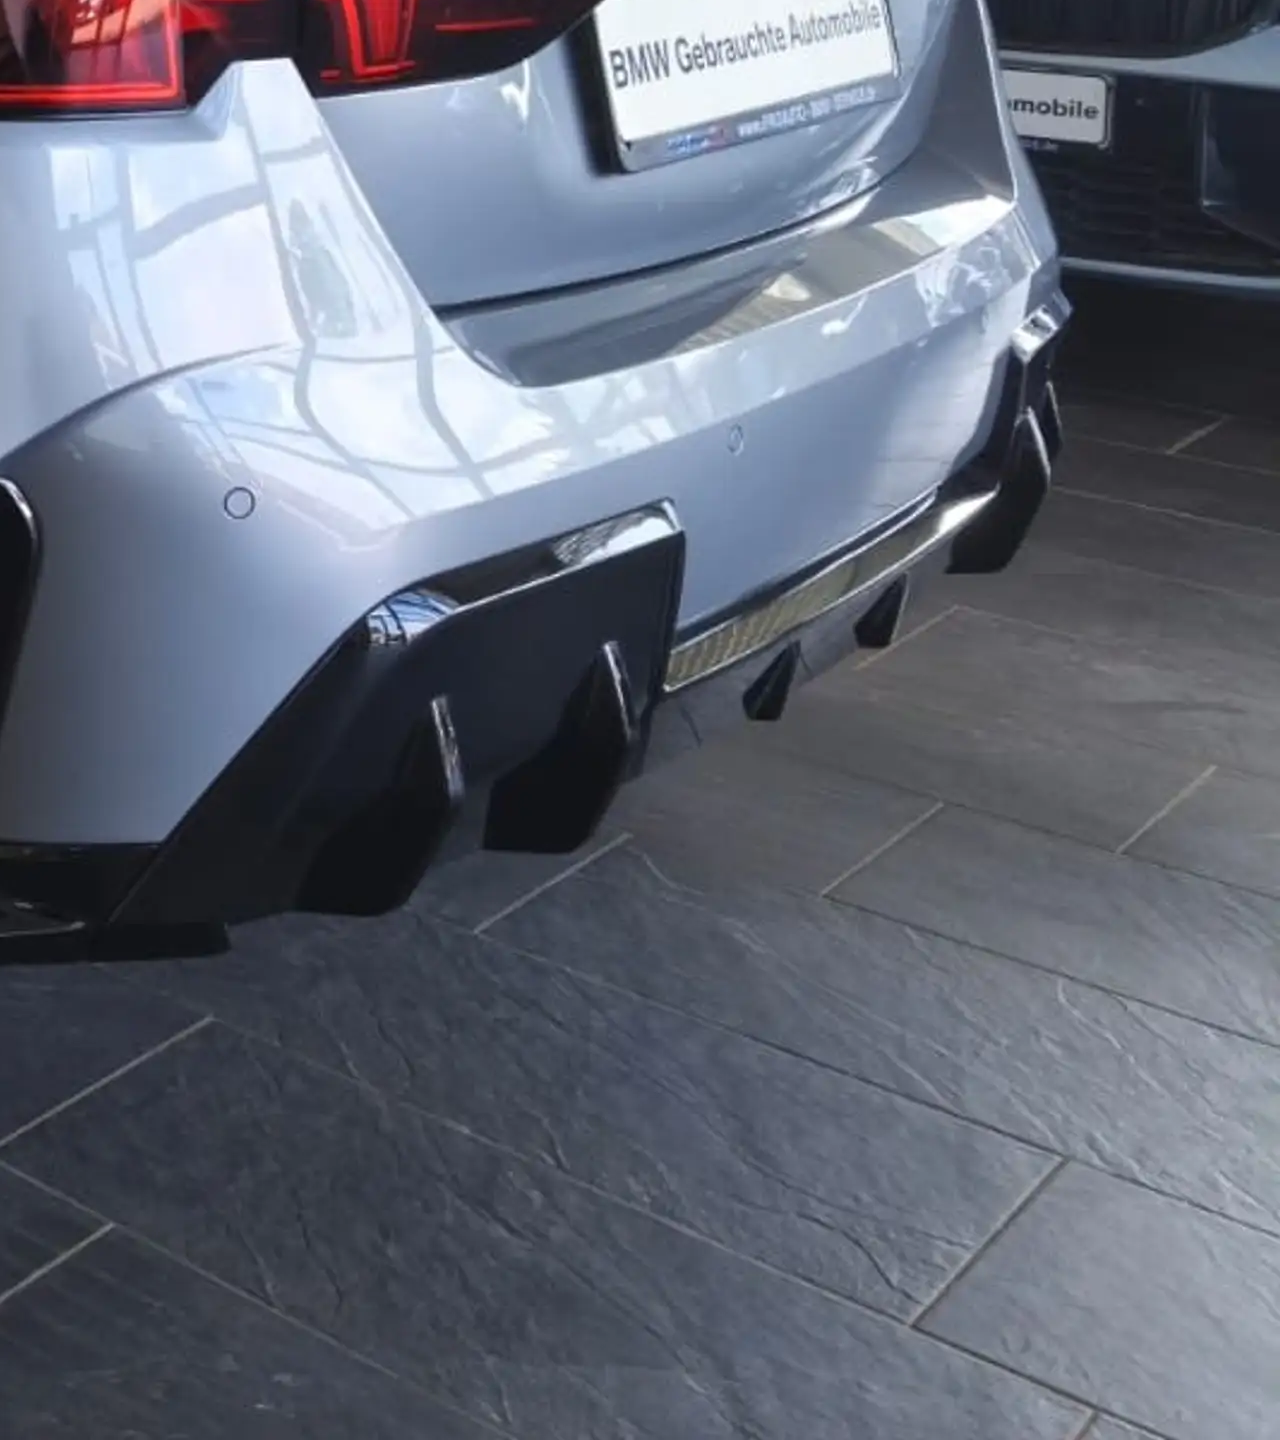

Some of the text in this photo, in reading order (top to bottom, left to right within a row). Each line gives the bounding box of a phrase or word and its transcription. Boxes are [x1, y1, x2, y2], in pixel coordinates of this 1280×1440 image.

[609, 0, 881, 90] BMW Gebrauchte Automobile
